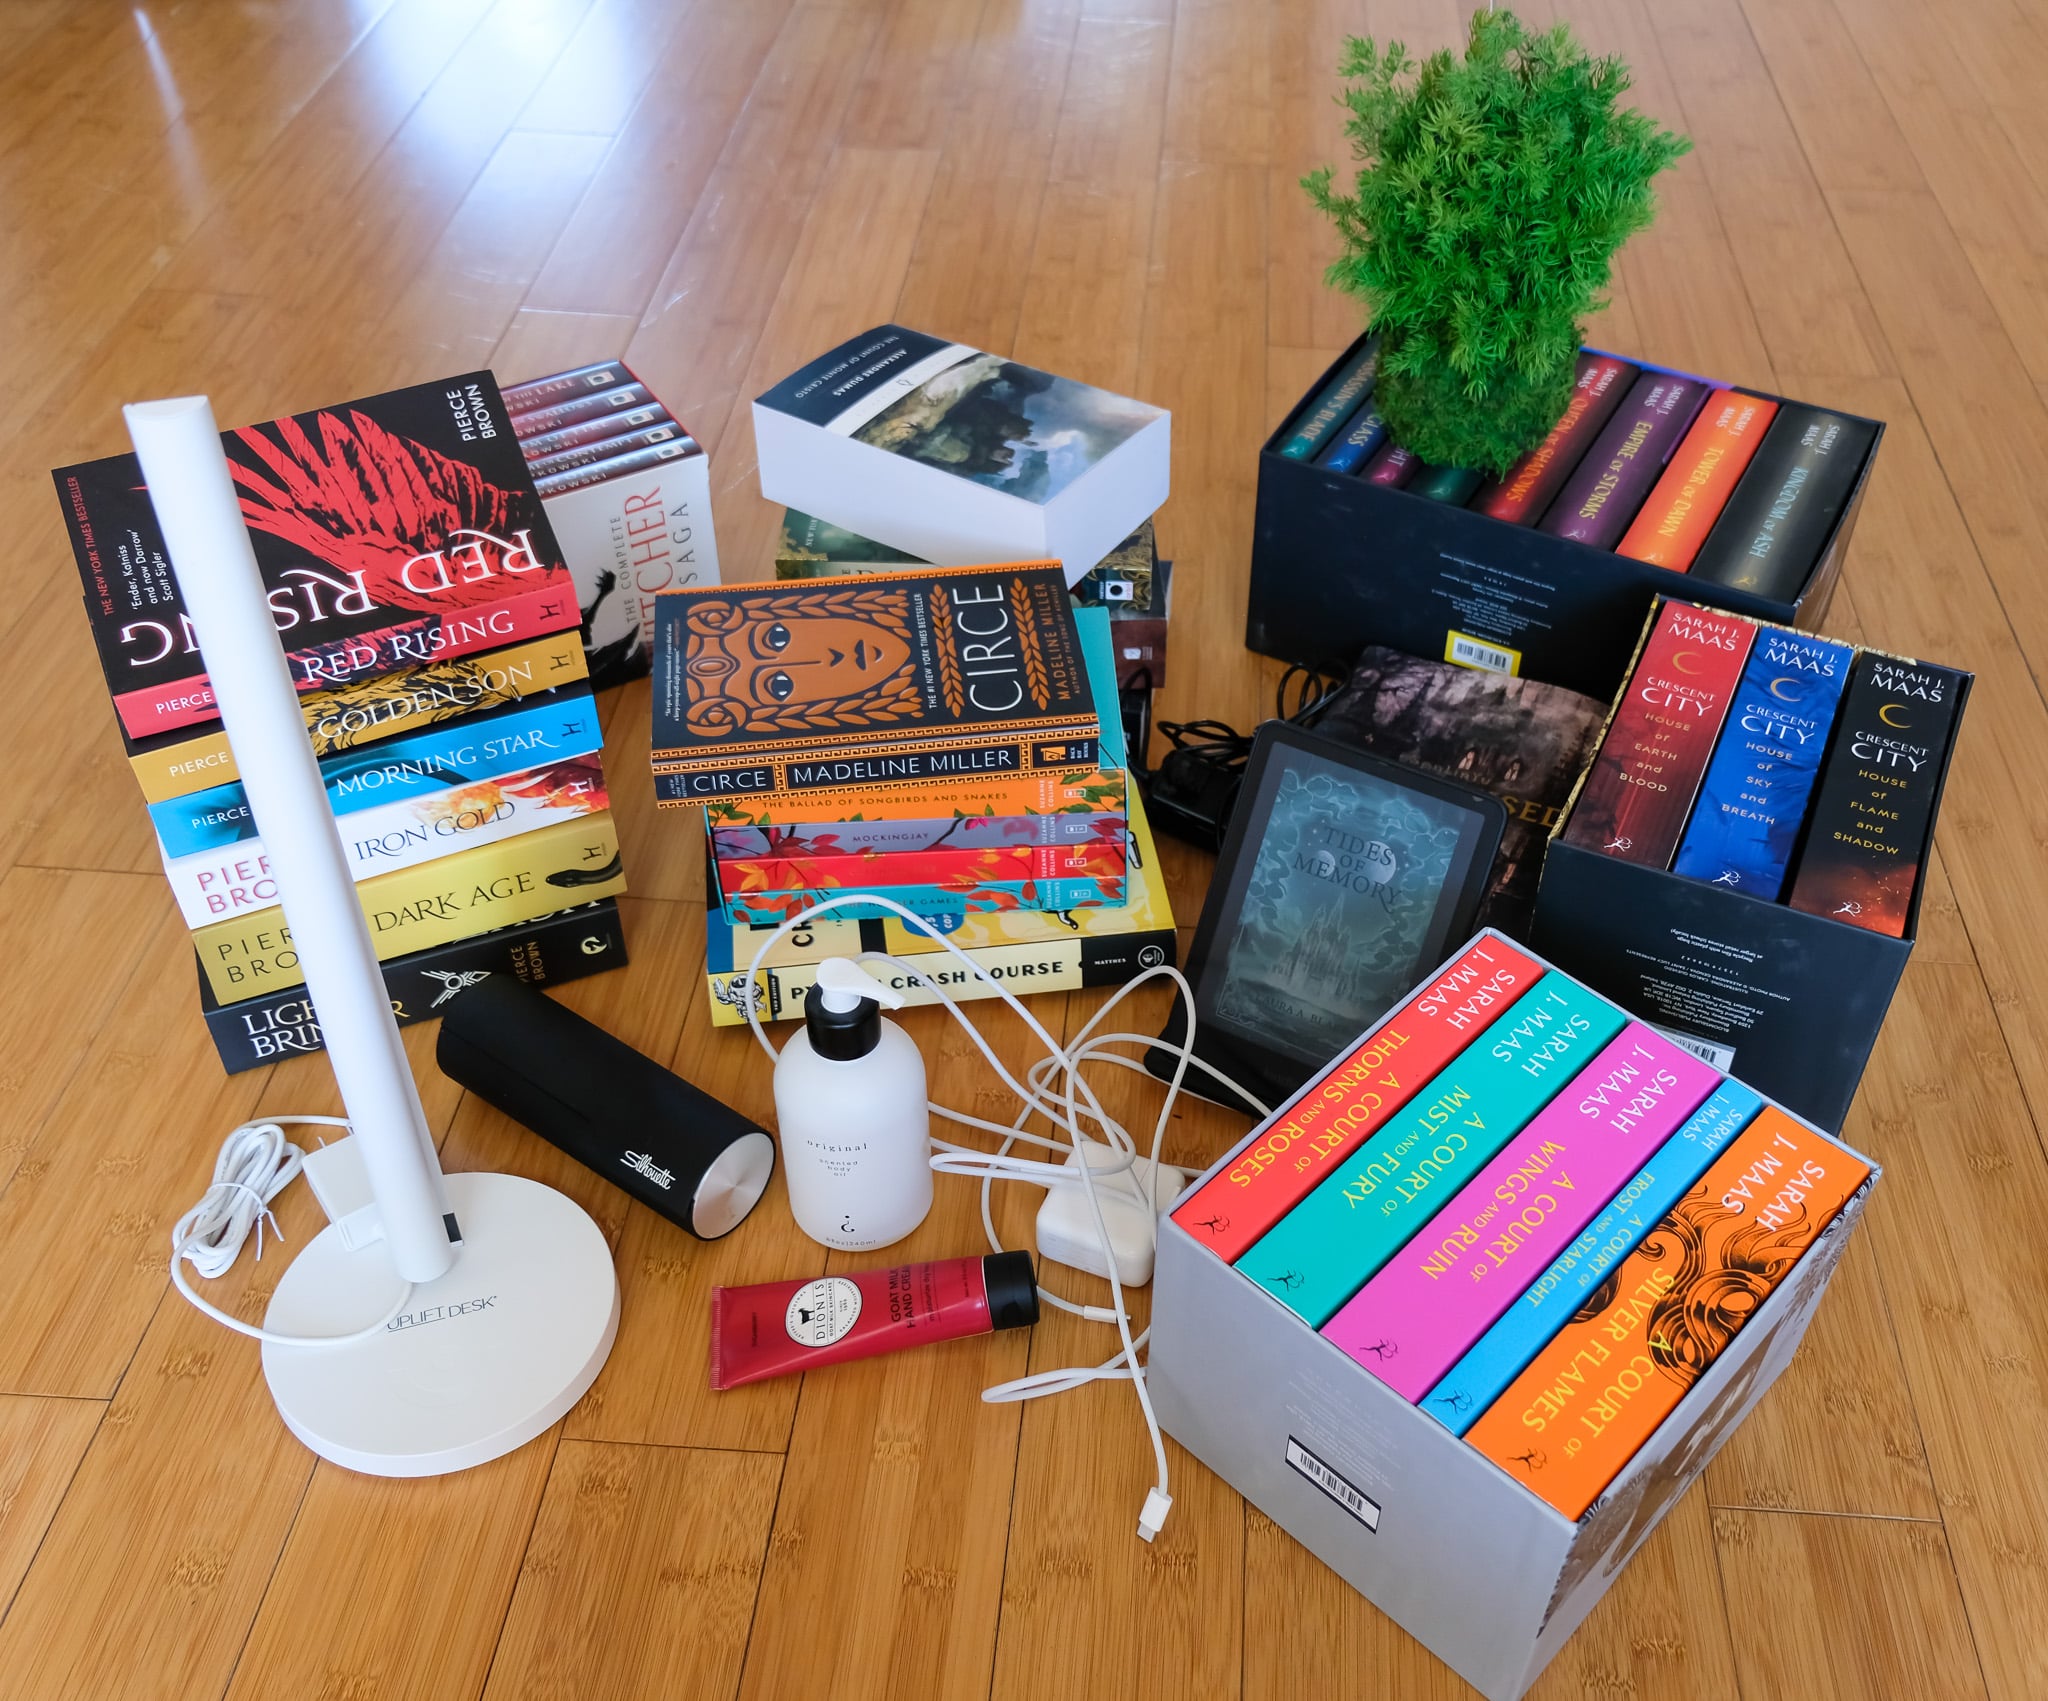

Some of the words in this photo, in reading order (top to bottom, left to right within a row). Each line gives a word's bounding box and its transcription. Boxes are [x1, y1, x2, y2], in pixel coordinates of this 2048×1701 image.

[823, 364, 849, 382] MONTE
[848, 356, 860, 365] OF
[864, 348, 907, 378] ALEXANDRE
[795, 380, 823, 398] CRISTO
[832, 375, 864, 397] DUMAS
[447, 390, 476, 441] PIERCE
[467, 384, 497, 440] BROWN
[1555, 398, 1589, 433] QUEEN
[1617, 421, 1653, 460] EMPIRE
[1800, 424, 1820, 448] MAAS
[1820, 424, 1840, 450] SARAH
[1506, 447, 1554, 502] SHADOWS
[1694, 446, 1724, 486] TOWER
[66, 476, 88, 522] BESTSELLER
[1579, 473, 1619, 520] STORMS
[1769, 466, 1809, 521] KINGDOM
[1657, 499, 1692, 538] DAWN
[82, 522, 95, 551] TIMES
[670, 503, 699, 585] SAGA
[1749, 533, 1774, 559] ASH
[88, 549, 102, 575] YORK
[118, 545, 134, 577] Katniss
[152, 551, 168, 578] Sigler
[401, 528, 545, 594] RED
[609, 516, 632, 590] COMPLETE
[96, 576, 108, 596] NEW
[141, 567, 153, 587] now
[160, 580, 174, 601] Scott
[102, 596, 115, 616] THE
[145, 587, 158, 604] and
[1034, 583, 1054, 626] MILLER
[120, 569, 378, 667] RISG
[623, 598, 637, 624] THE
[914, 593, 927, 629] BESTSELLER
[920, 629, 930, 648] TIMES
[1668, 623, 1736, 652] MAAS
[1672, 612, 1728, 634] SARAH
[1730, 628, 1740, 639] J.
[302, 646, 377, 683] RED
[392, 610, 514, 661] RISING
[922, 648, 932, 668] YORK
[953, 584, 1022, 712] CIRCE
[925, 668, 934, 685] NEW
[1044, 630, 1071, 700] MADELINE
[155, 691, 213, 714] PIERCE
[319, 684, 476, 738] GOLDEN
[466, 661, 532, 700] SON
[1641, 687, 1713, 717] CITY
[1646, 676, 1716, 702] CRESCENT
[929, 697, 937, 709] THE
[1644, 713, 1692, 732] HOUSE
[1740, 714, 1815, 745] CITY
[1746, 704, 1818, 730] CRESCENT
[1634, 743, 1678, 761] EARTH
[1746, 741, 1793, 760] HOUSE
[1851, 742, 1927, 774] CITY
[1855, 731, 1929, 758] CRESCENT
[169, 751, 229, 777] PIERCE
[336, 746, 477, 796] MORNING
[485, 730, 560, 759] STAR
[794, 757, 920, 784] MADELINE
[930, 750, 1012, 771] MILLER
[1636, 761, 1663, 774] and
[694, 771, 766, 792] CIRCE
[1619, 772, 1668, 792] BLOOD
[1746, 775, 1772, 789] SKY
[1858, 769, 1908, 790] HOUSE
[763, 801, 784, 809] THE
[790, 799, 832, 808] BALLAD
[838, 798, 854, 806] OF
[860, 795, 928, 806] SONGBIRDS
[934, 794, 958, 802] AND
[964, 792, 1008, 801] SNAKES
[1740, 792, 1767, 806] and
[1850, 801, 1900, 821] FLAME
[191, 806, 250, 829] PIERCE
[1721, 804, 1776, 825] BREATH
[1856, 821, 1885, 834] and
[354, 825, 428, 860] IRON
[434, 800, 515, 836] GOLD
[853, 832, 929, 842] MOCKINGJAY
[1833, 830, 1899, 856] SHADOW
[1324, 826, 1394, 866] TIDES
[1340, 854, 1367, 874] OF
[1294, 852, 1402, 914] MEMORY
[372, 892, 462, 932] DARK
[470, 872, 536, 906] AGE
[920, 896, 958, 906] GAMES
[1472, 948, 1495, 962] J.
[1417, 964, 1480, 1017] MAAS
[1446, 968, 1515, 1030] SARAH
[1324, 1029, 1410, 1104] THORNS
[1378, 1072, 1401, 1090] A
[1300, 1101, 1326, 1126] AND
[1418, 1085, 1472, 1137] MIST
[1464, 1112, 1487, 1130] A
[1309, 1092, 1382, 1160] COURT
[807, 1140, 867, 1152] original
[1229, 1120, 1306, 1188] ROSES
[1395, 1130, 1420, 1157] AND
[1773, 1132, 1798, 1150] J.
[620, 1150, 676, 1190] Silhouette
[1294, 1155, 1312, 1174] OF
[1394, 1132, 1468, 1204] COURT
[1494, 1138, 1568, 1206] WINGS
[1342, 1152, 1402, 1209] FURY
[1552, 1170, 1576, 1191] A
[1612, 1170, 1656, 1213] FROST
[1722, 1151, 1783, 1214] MAAS
[1380, 1198, 1398, 1218] OF
[1756, 1160, 1825, 1232] SARAH
[1478, 1202, 1500, 1229] AND
[1594, 1214, 1615, 1234] AND
[1629, 1214, 1644, 1228] A
[1484, 1193, 1558, 1268] COURT
[1418, 1222, 1480, 1280] RUIN
[1586, 1228, 1634, 1275] COURT
[1470, 1262, 1490, 1284] OF
[1526, 1228, 1598, 1308] STARLIGHT
[1576, 1270, 1594, 1287] OF
[387, 1306, 445, 1330] UPLIFT
[449, 1296, 494, 1317] DESK
[814, 1283, 826, 1340] DIONIS
[890, 1292, 901, 1322] GOAT
[902, 1294, 916, 1328] HAND
[1602, 1267, 1676, 1340] SILVER
[1647, 1330, 1673, 1353] A
[1522, 1338, 1612, 1433] FLAMES
[1580, 1354, 1654, 1438] COURT
[1562, 1436, 1582, 1460] OF
